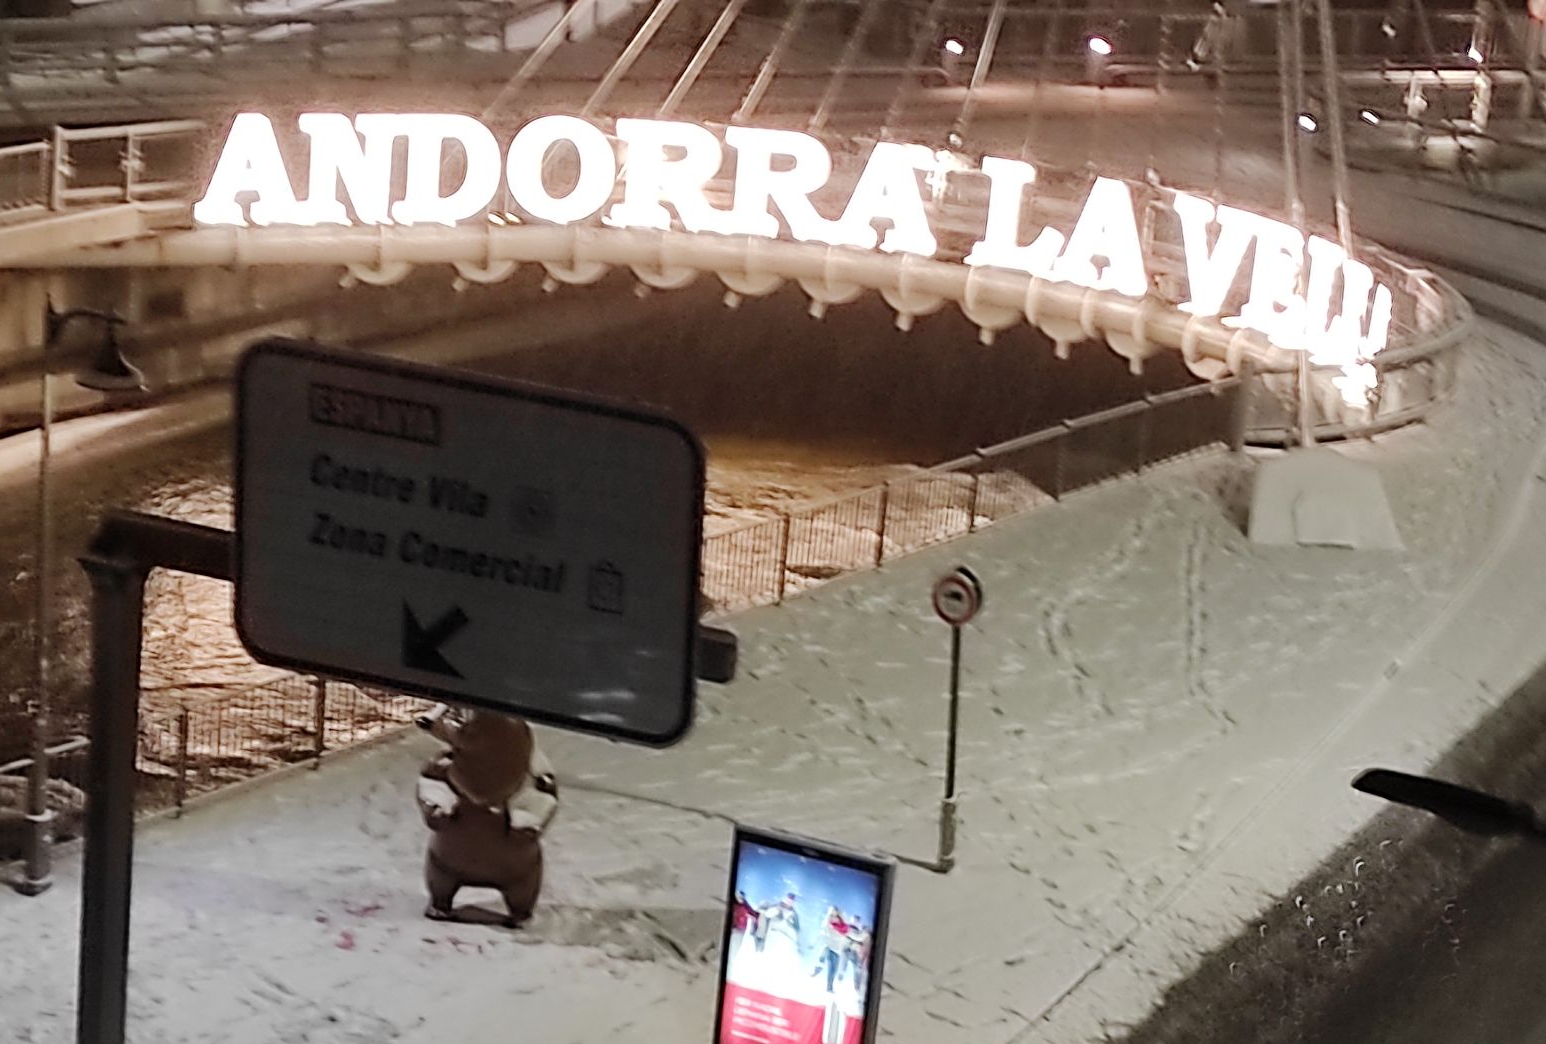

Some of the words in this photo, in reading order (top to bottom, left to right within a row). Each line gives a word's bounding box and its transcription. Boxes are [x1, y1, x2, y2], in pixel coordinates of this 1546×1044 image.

[194, 112, 938, 258] ANDORRA
[968, 154, 1147, 297] LA
[310, 452, 416, 503] Centre
[429, 475, 489, 518] Vila
[310, 512, 388, 557] Zona
[400, 530, 566, 593] Comercial
